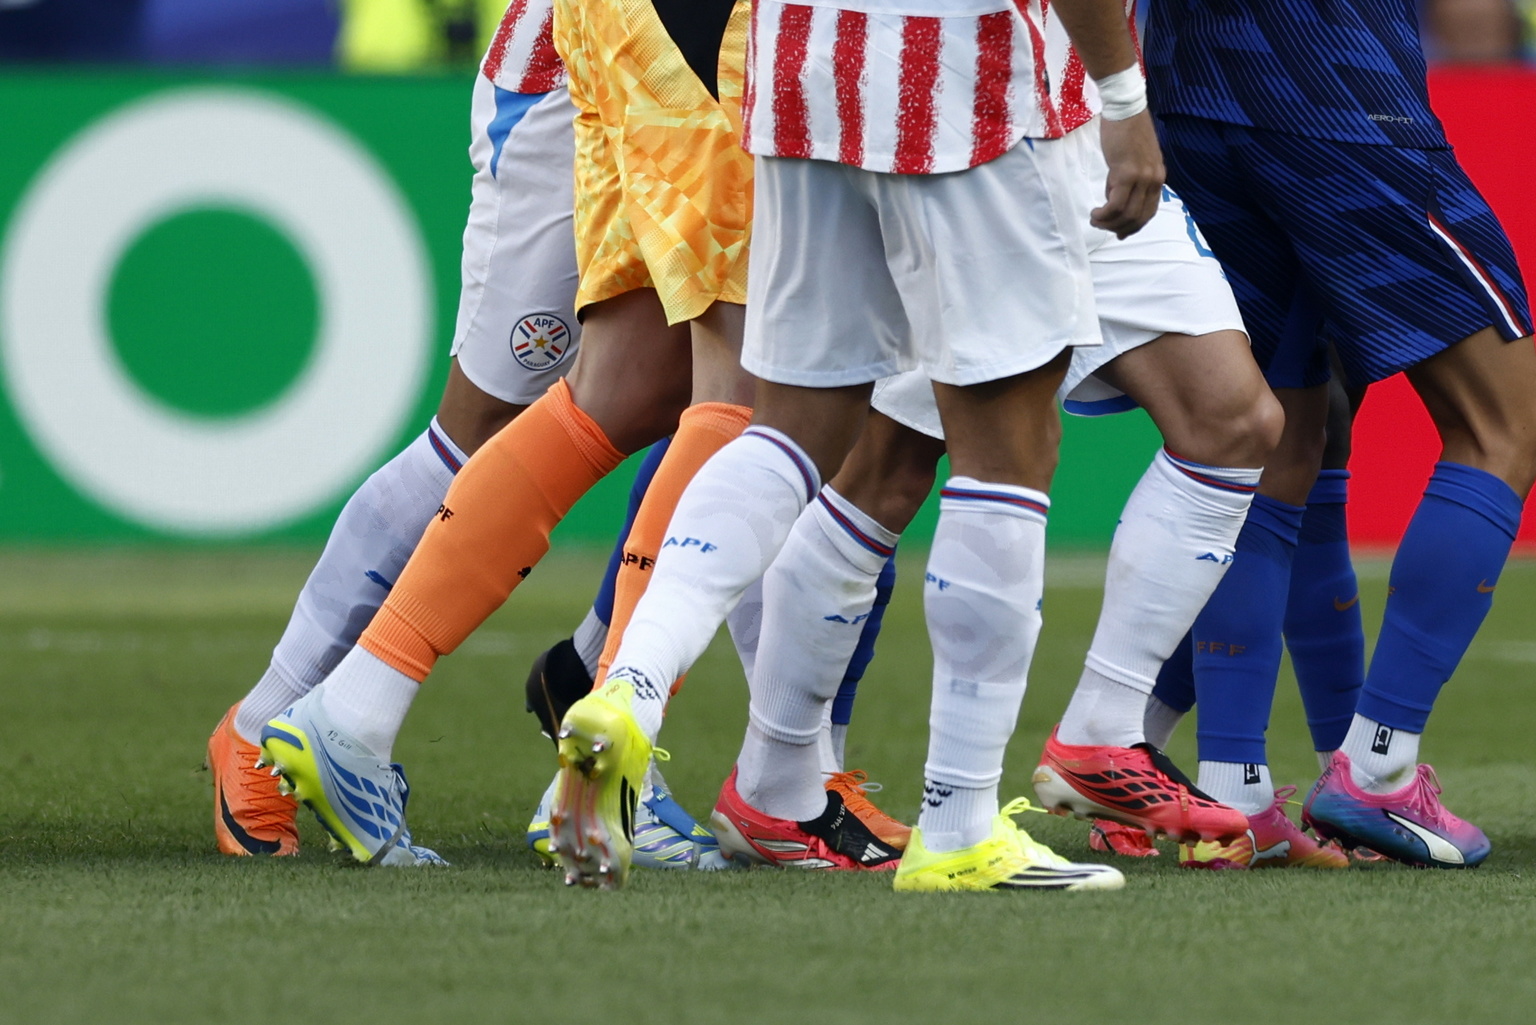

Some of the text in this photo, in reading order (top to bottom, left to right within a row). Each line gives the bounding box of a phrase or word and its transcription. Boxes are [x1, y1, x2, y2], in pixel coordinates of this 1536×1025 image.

[533, 317, 555, 329] APF
[523, 358, 551, 368] PARAGUAY
[435, 503, 454, 522] PF
[662, 536, 717, 554] APF
[1195, 552, 1235, 565] AP
[925, 572, 950, 592] PF
[824, 614, 870, 625] AP
[1197, 641, 1247, 657] FFF
[327, 730, 353, 750] 12 Gill
